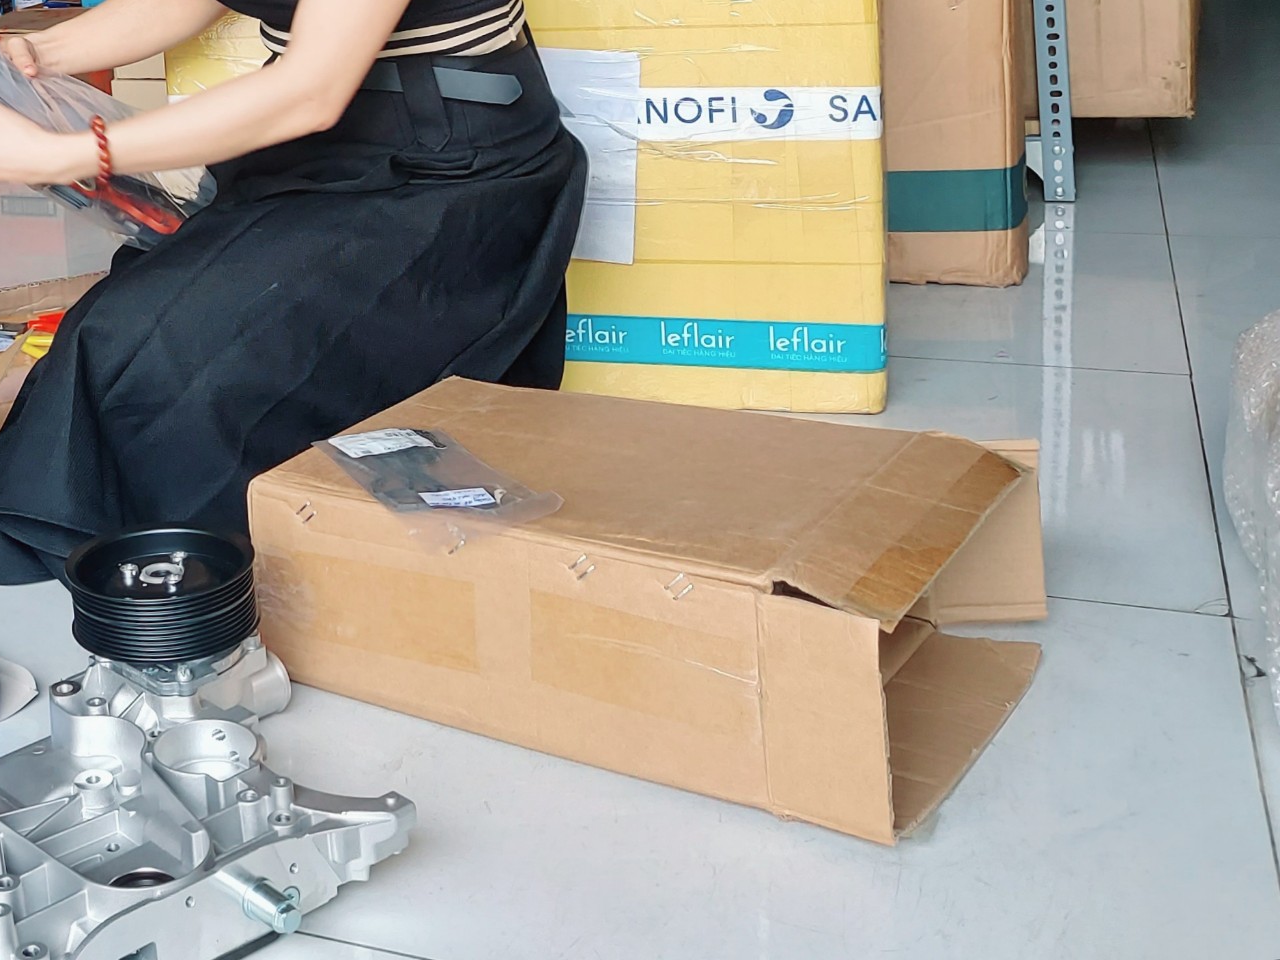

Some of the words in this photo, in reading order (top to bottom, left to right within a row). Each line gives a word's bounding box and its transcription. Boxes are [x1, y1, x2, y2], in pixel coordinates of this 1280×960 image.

[637, 96, 737, 125] NOFI
[828, 94, 882, 124] SA
[566, 318, 628, 345] eflair
[660, 320, 735, 349] leflair
[769, 325, 847, 354] leflair
